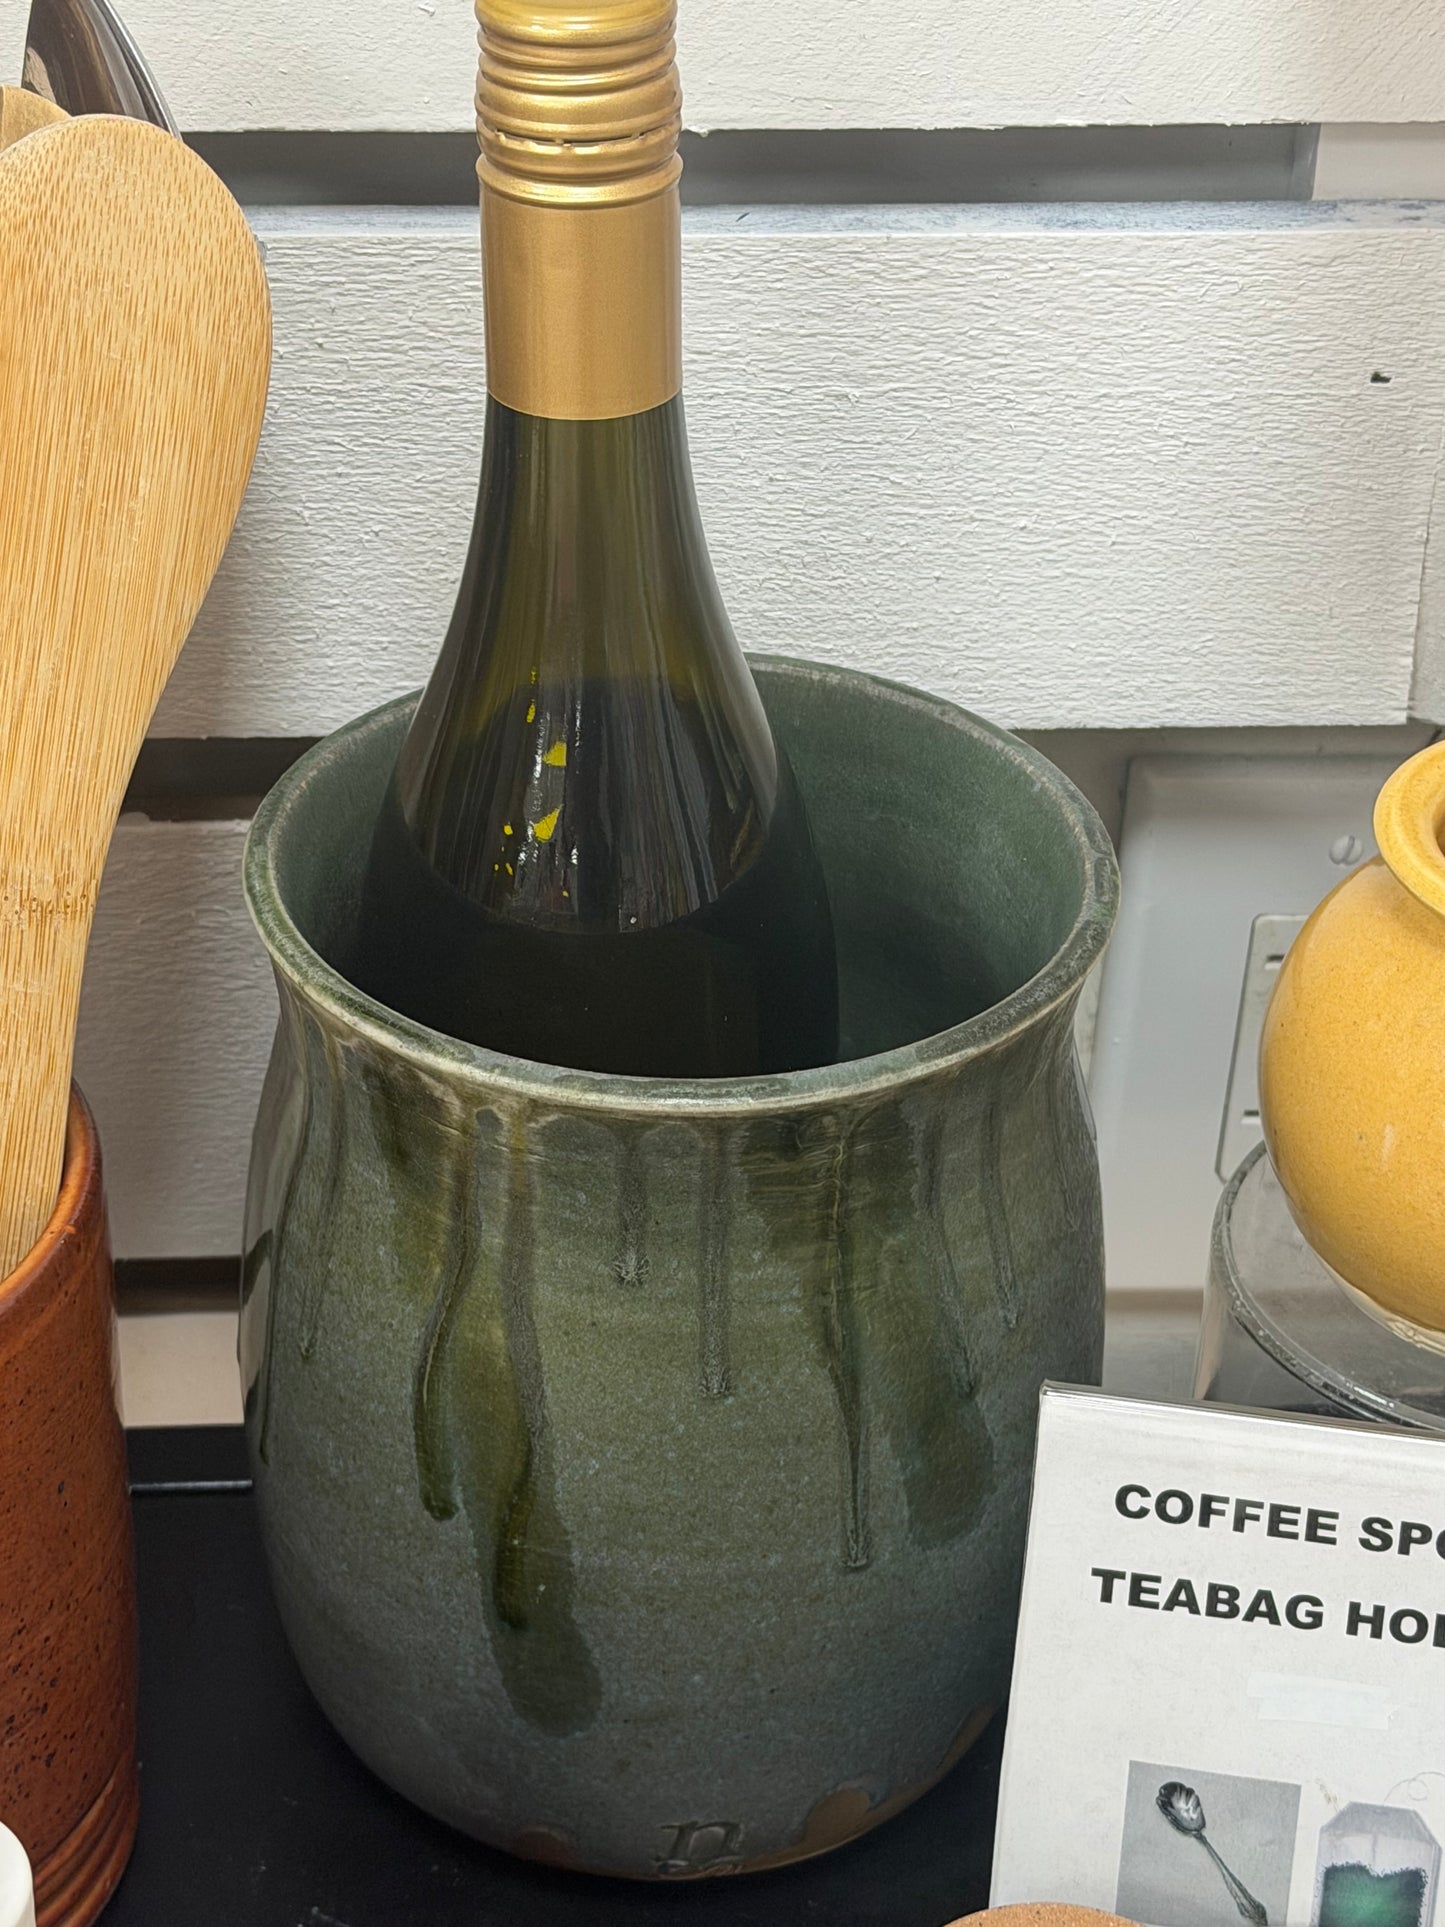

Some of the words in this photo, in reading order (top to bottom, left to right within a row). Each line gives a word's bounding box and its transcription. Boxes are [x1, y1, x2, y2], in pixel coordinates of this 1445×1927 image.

[1115, 1484, 1339, 1546] COFFEE
[1358, 1517, 1445, 1560] SP
[1091, 1567, 1324, 1630] TEABAG
